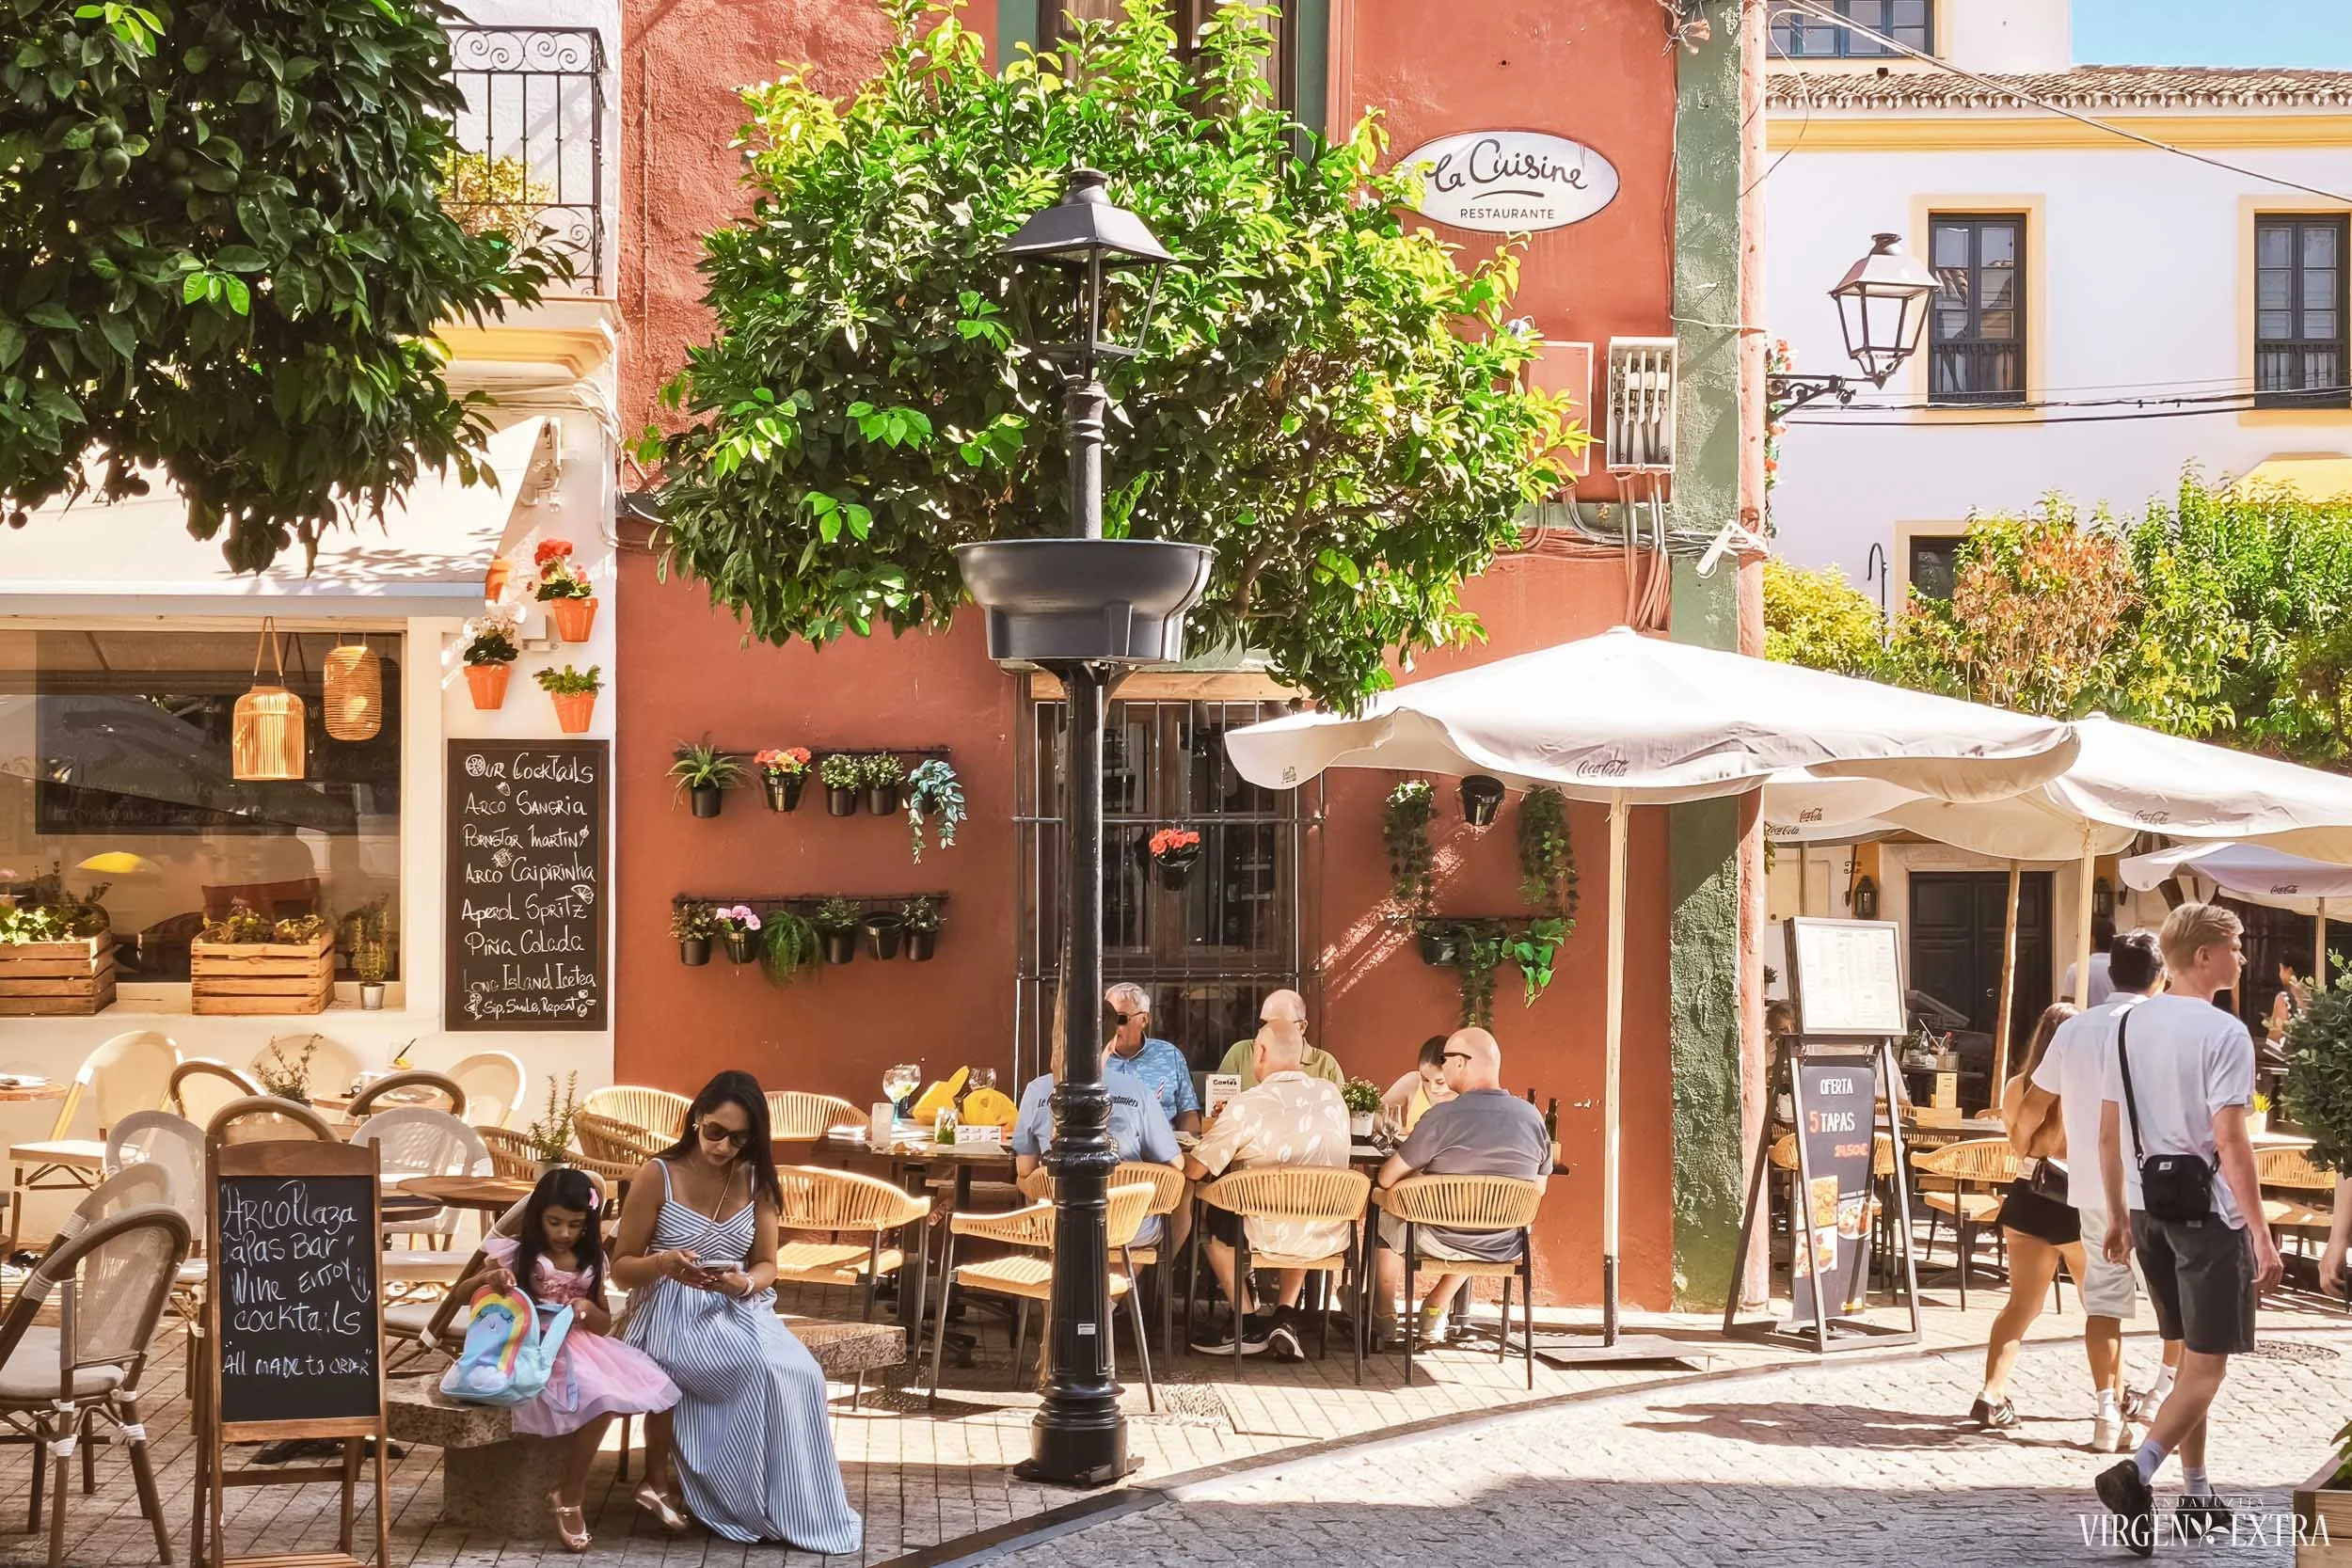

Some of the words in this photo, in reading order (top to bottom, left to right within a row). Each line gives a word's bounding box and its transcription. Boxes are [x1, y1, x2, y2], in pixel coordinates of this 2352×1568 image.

[1470, 138, 1588, 190] Cuisine
[1460, 208, 1555, 219] RESTAURANTE
[1820, 1078, 1854, 1096] OFERTA
[1809, 1111, 1820, 1133] 5
[1820, 1112, 1855, 1133] TAPAS
